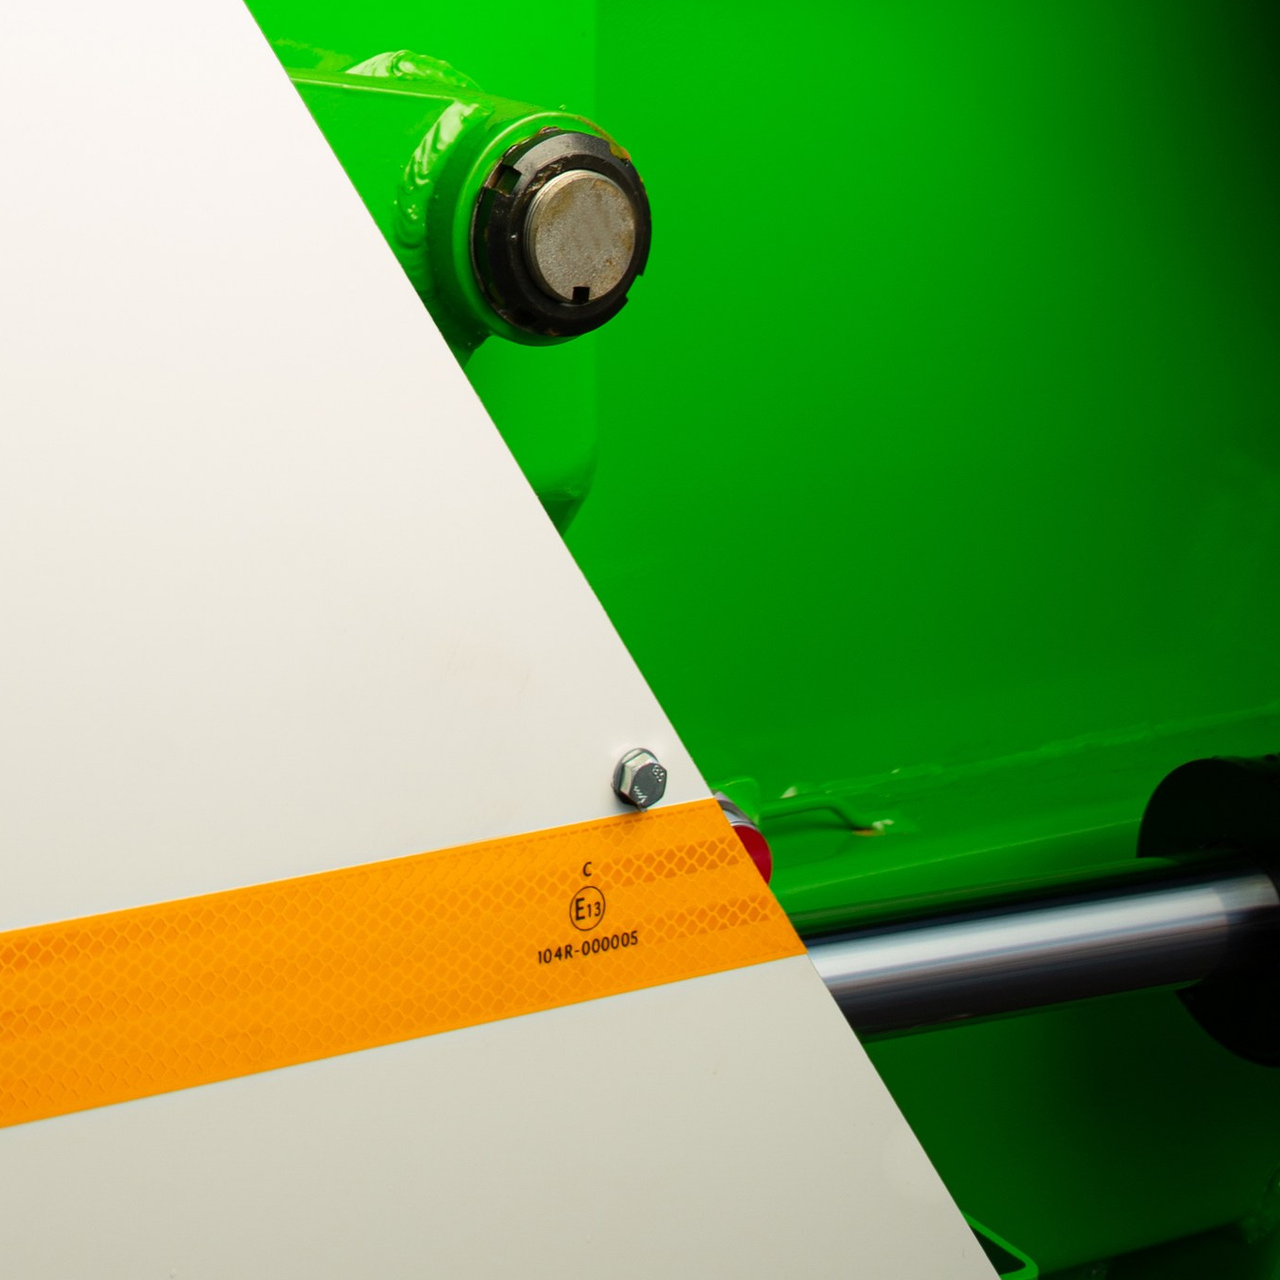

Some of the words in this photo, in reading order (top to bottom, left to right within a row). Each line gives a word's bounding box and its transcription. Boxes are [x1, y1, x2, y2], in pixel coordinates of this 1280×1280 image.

[582, 861, 592, 877] C
[575, 897, 601, 920] E13
[537, 930, 639, 964] 104R-000005
